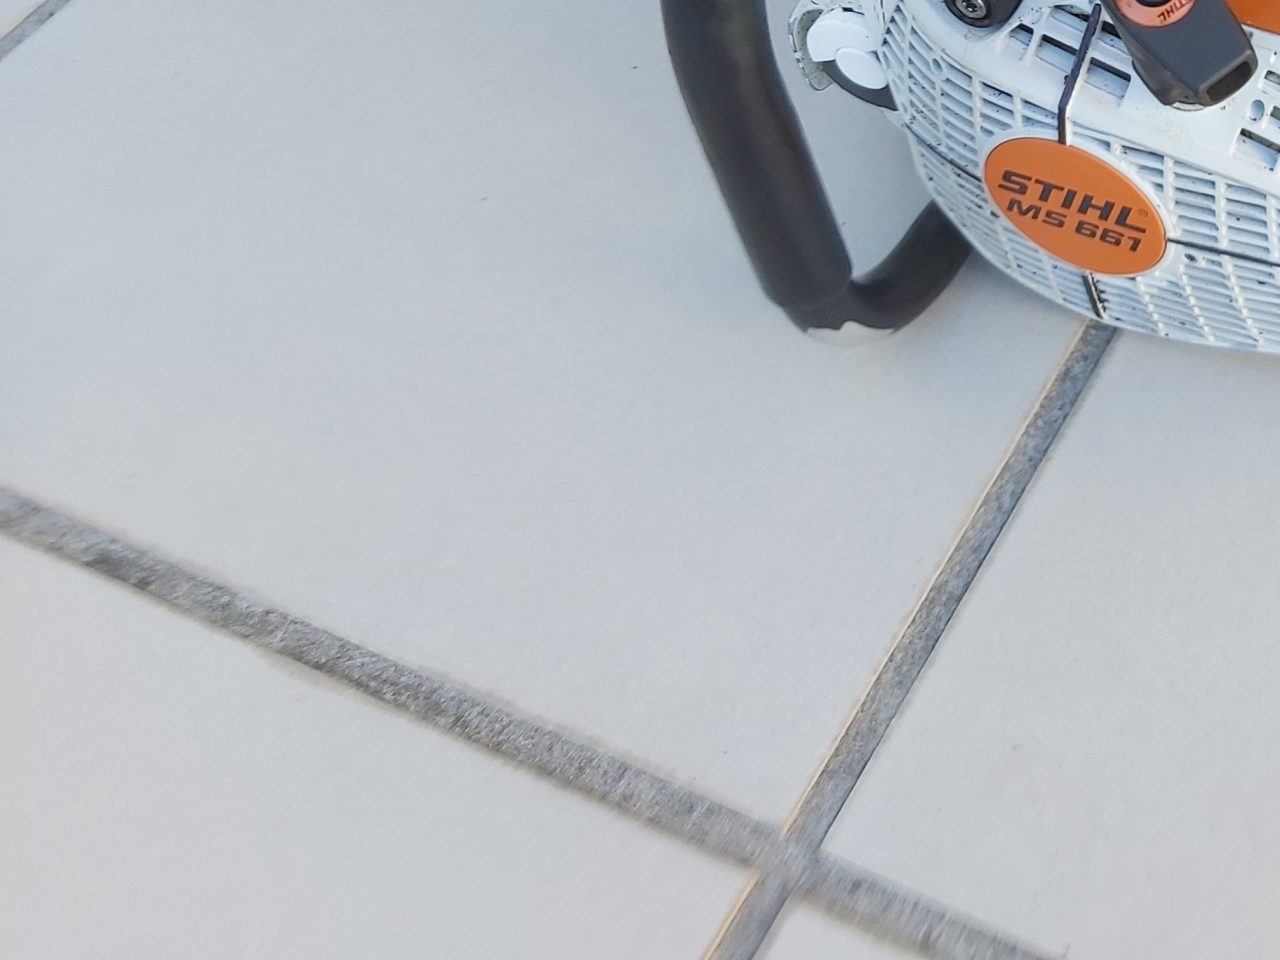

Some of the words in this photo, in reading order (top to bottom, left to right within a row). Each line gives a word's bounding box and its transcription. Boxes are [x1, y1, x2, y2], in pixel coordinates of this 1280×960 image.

[998, 169, 1147, 234] STIHL
[1007, 198, 1067, 228] MS
[1075, 220, 1142, 252] 661
